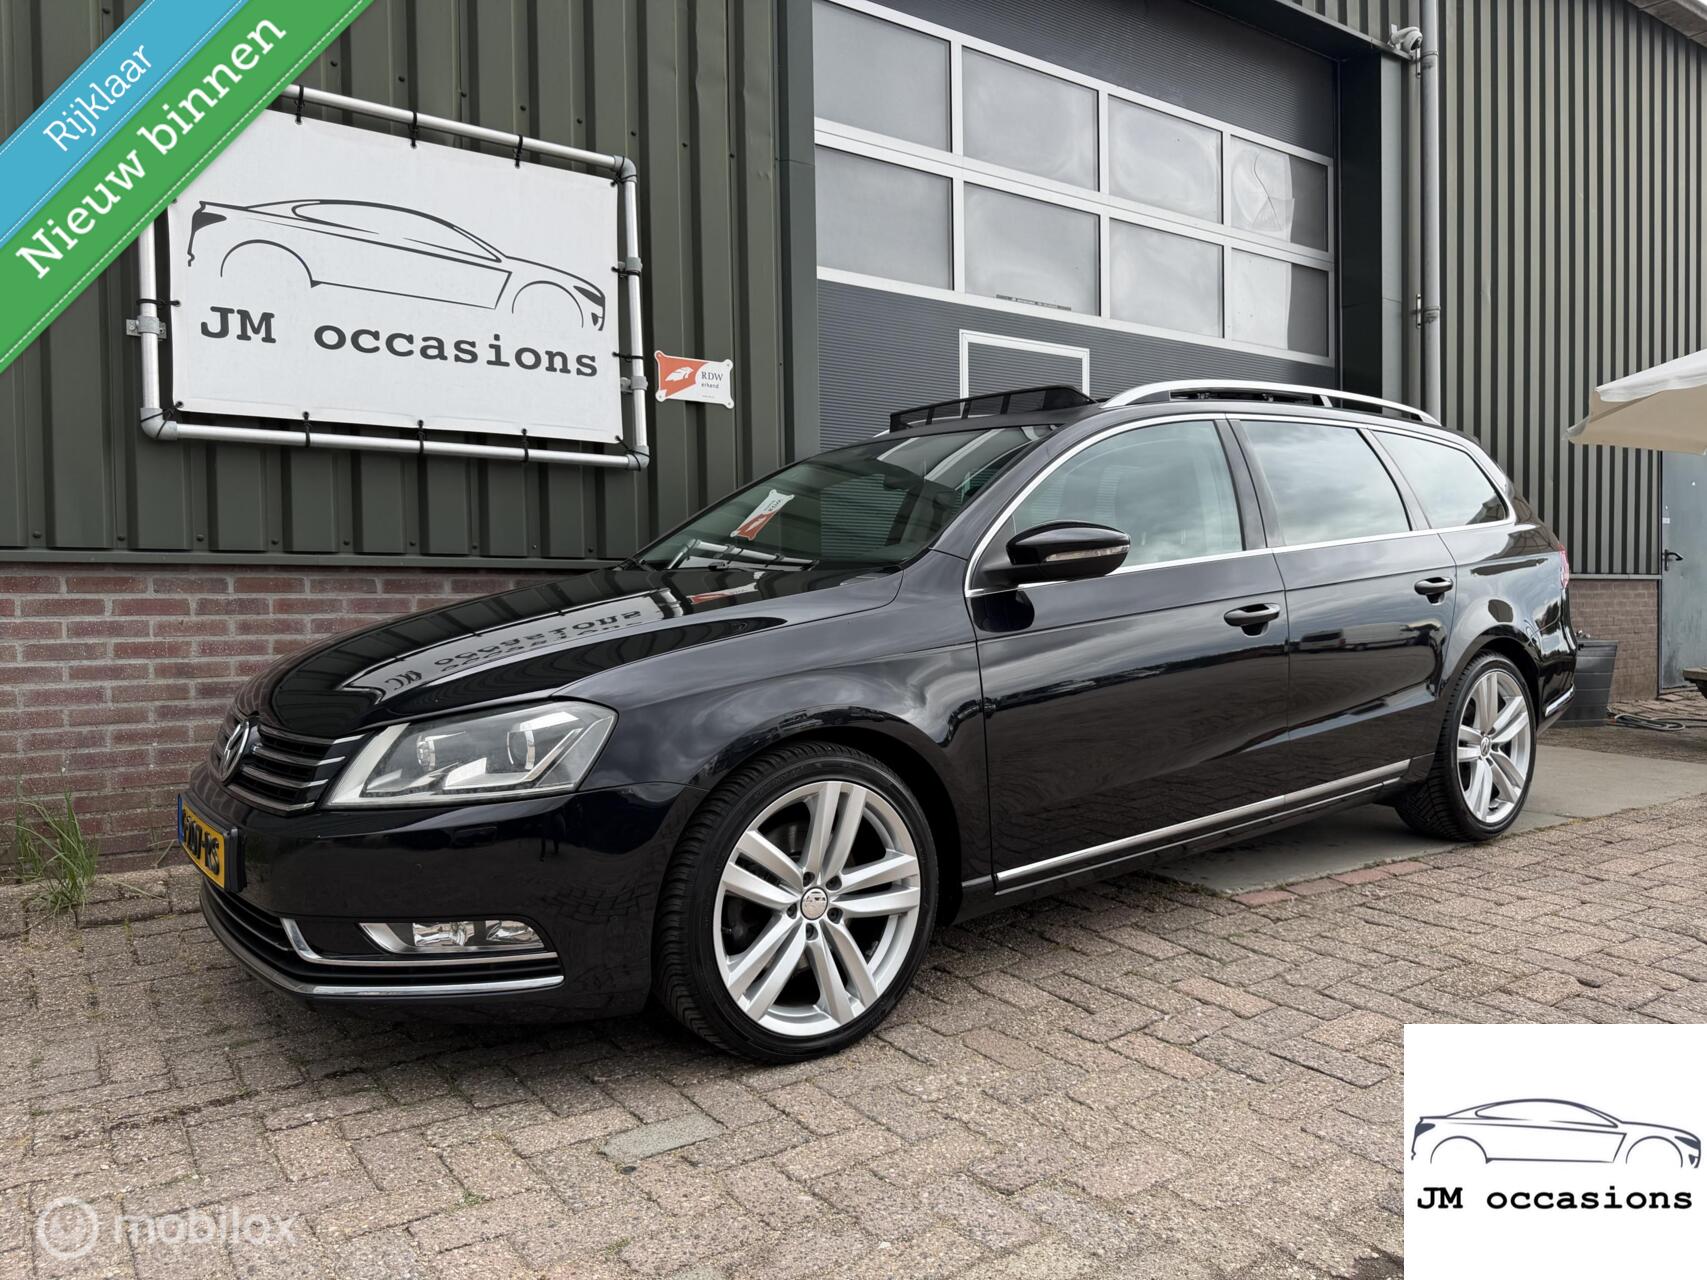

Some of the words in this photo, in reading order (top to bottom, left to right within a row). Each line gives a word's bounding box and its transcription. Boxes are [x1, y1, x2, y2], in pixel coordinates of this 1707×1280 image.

[200, 306, 277, 344] JM
[314, 324, 599, 378] occasions
[701, 371, 724, 382] RDW
